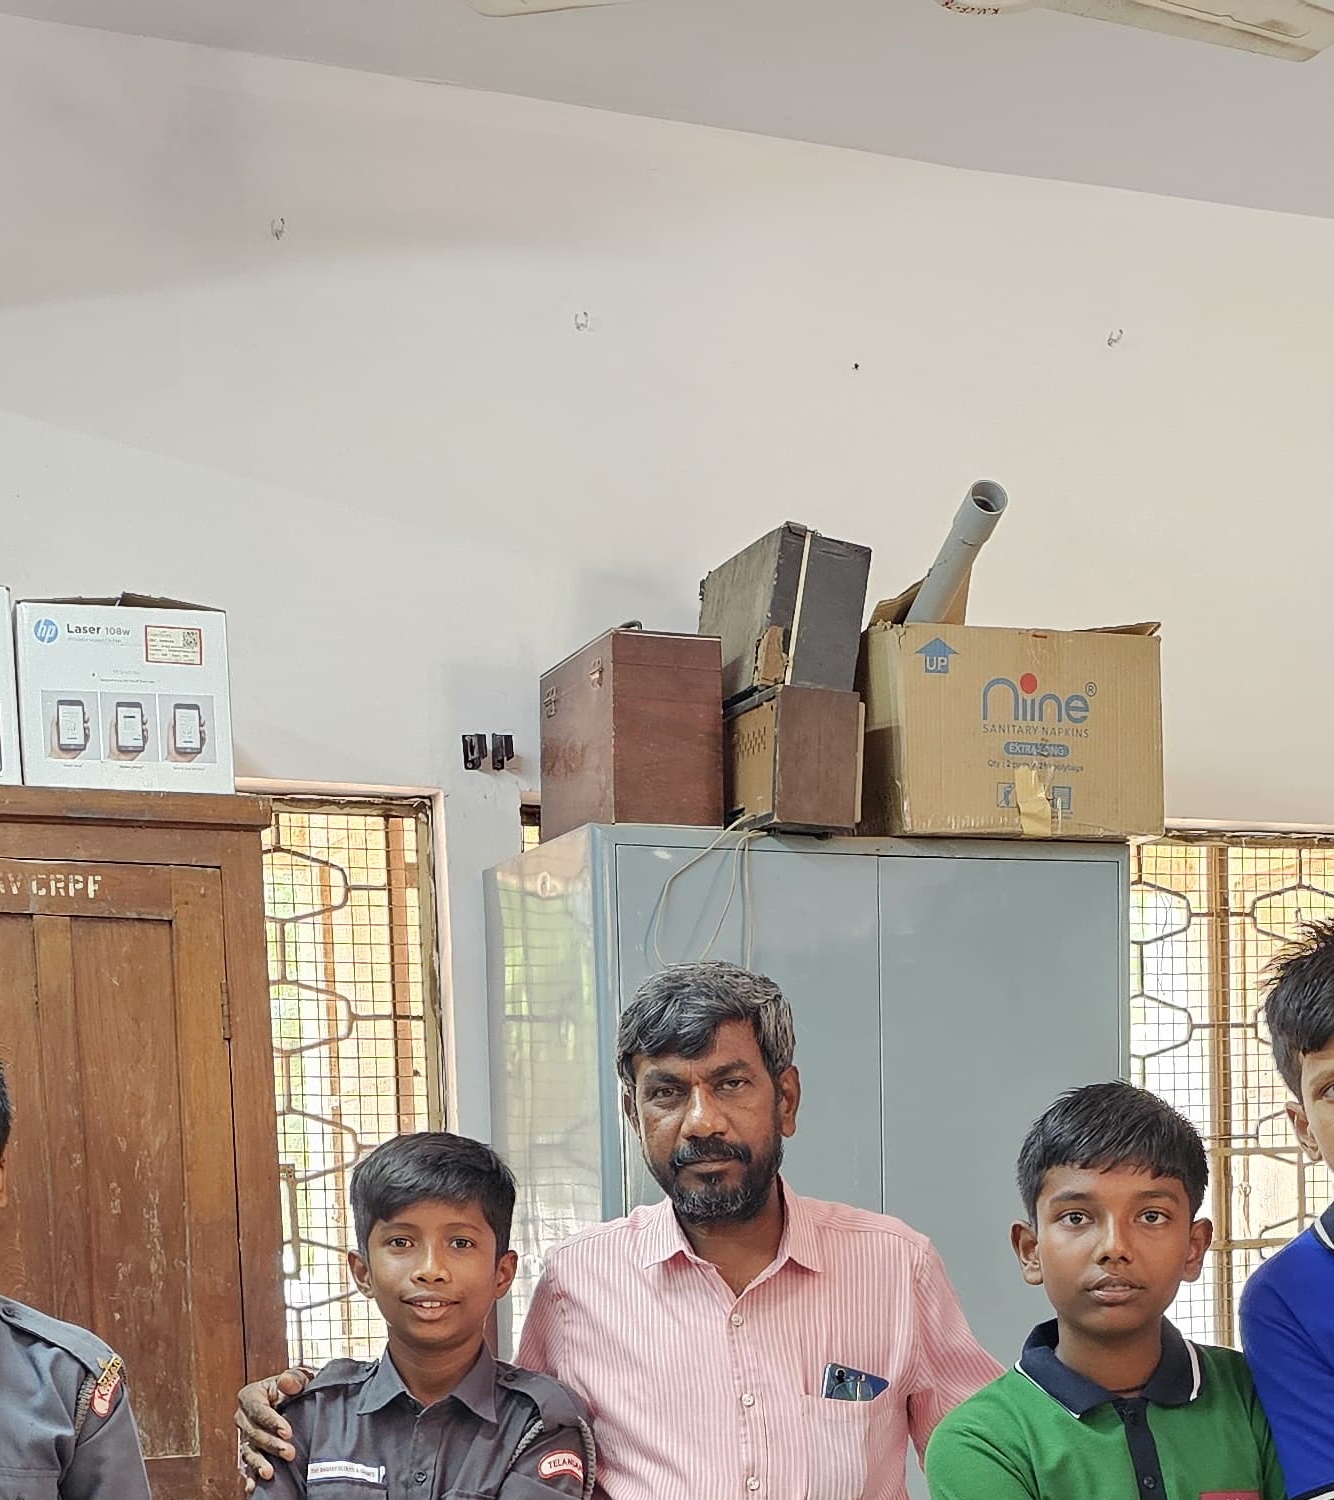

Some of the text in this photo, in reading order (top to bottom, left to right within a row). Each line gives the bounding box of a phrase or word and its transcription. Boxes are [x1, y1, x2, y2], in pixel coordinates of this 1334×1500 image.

[35, 618, 58, 644] hp
[66, 623, 131, 636] Laser 108w
[925, 656, 948, 671] UP
[982, 723, 1090, 738] SANITARY NAPKINS
[30, 873, 103, 899] CRPF
